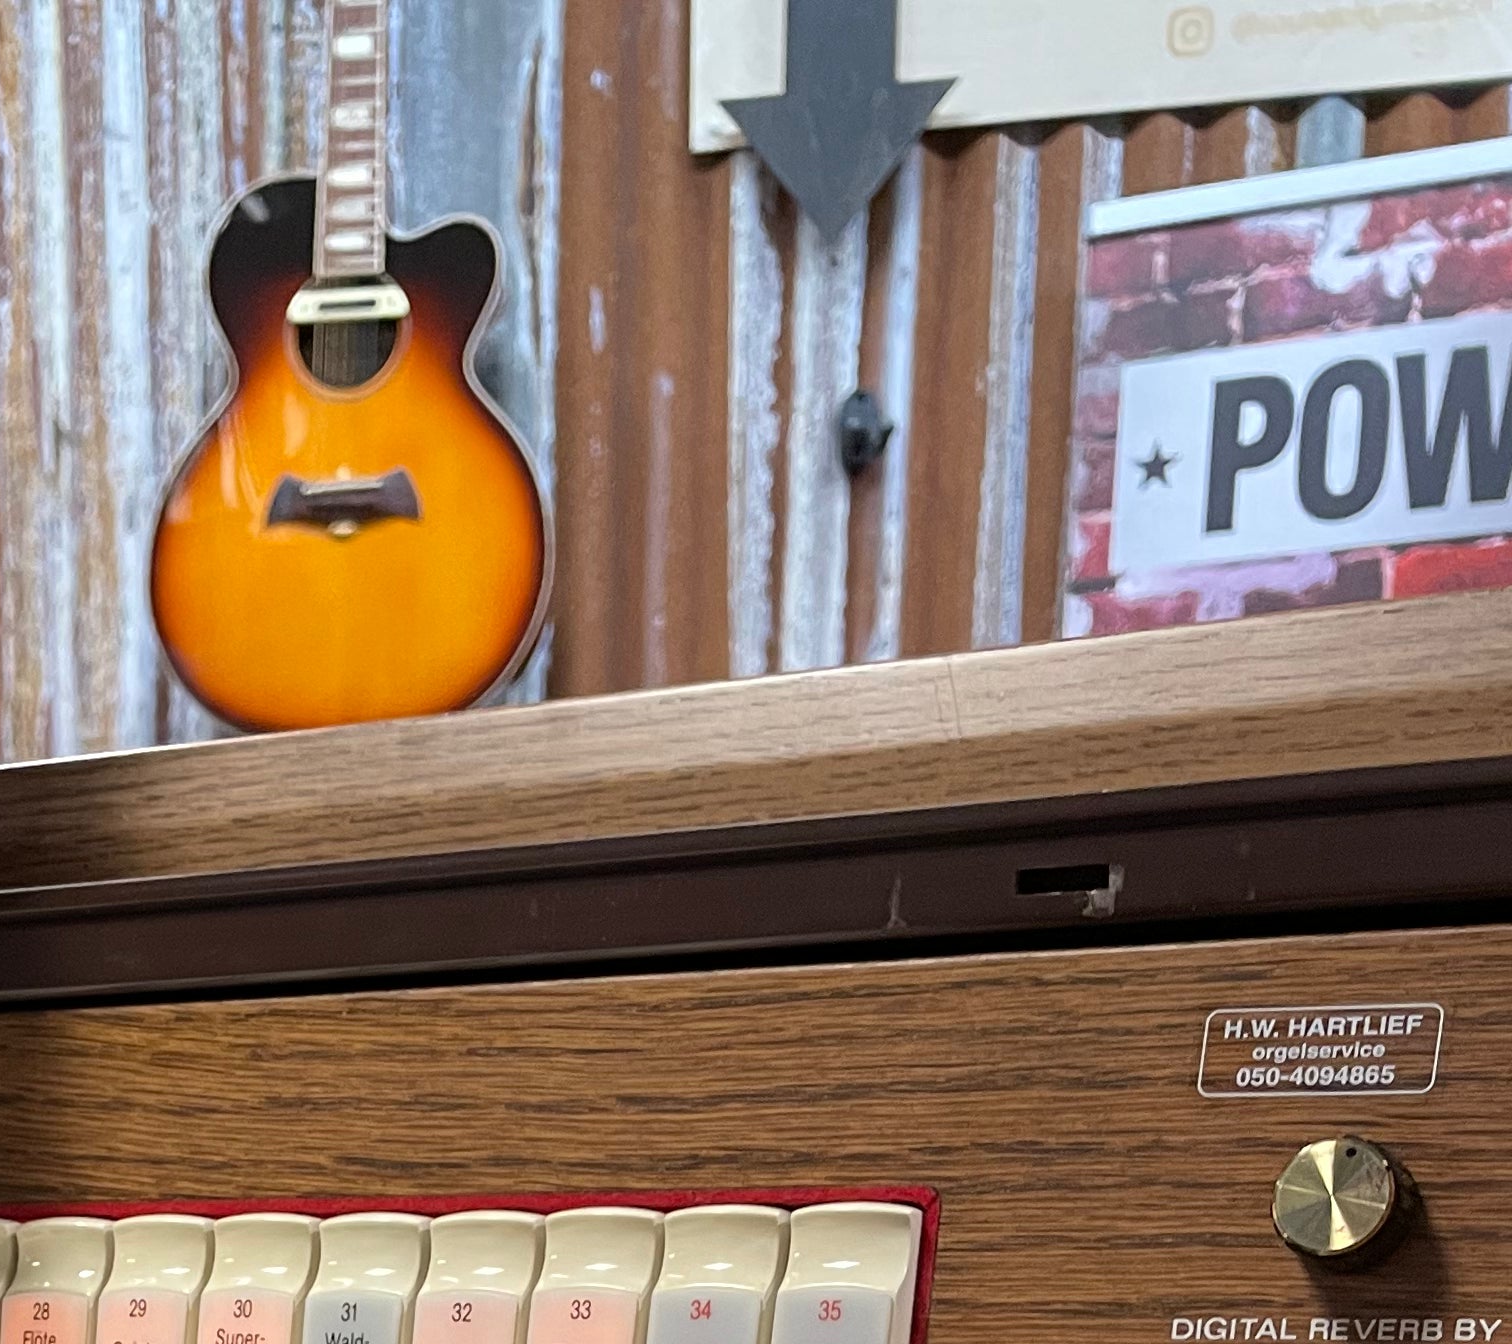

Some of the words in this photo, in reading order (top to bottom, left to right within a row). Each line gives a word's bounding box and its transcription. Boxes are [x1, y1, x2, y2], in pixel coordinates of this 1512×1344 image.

[1224, 1018, 1279, 1039] H.W.
[1288, 1014, 1424, 1037] HARTLIEF
[1252, 1041, 1386, 1063] orgelservice
[1236, 1064, 1396, 1087] 050-4094865
[33, 1302, 50, 1321] 28
[129, 1299, 147, 1318] 29
[232, 1299, 253, 1318] 30
[340, 1302, 357, 1322] 31
[451, 1302, 472, 1323] 32
[570, 1300, 591, 1320] 33
[690, 1300, 712, 1320] 34
[818, 1300, 842, 1321] 35
[1171, 1317, 1297, 1341] DIGITAL
[1308, 1318, 1443, 1342] REVERB
[1454, 1318, 1502, 1342] BY
